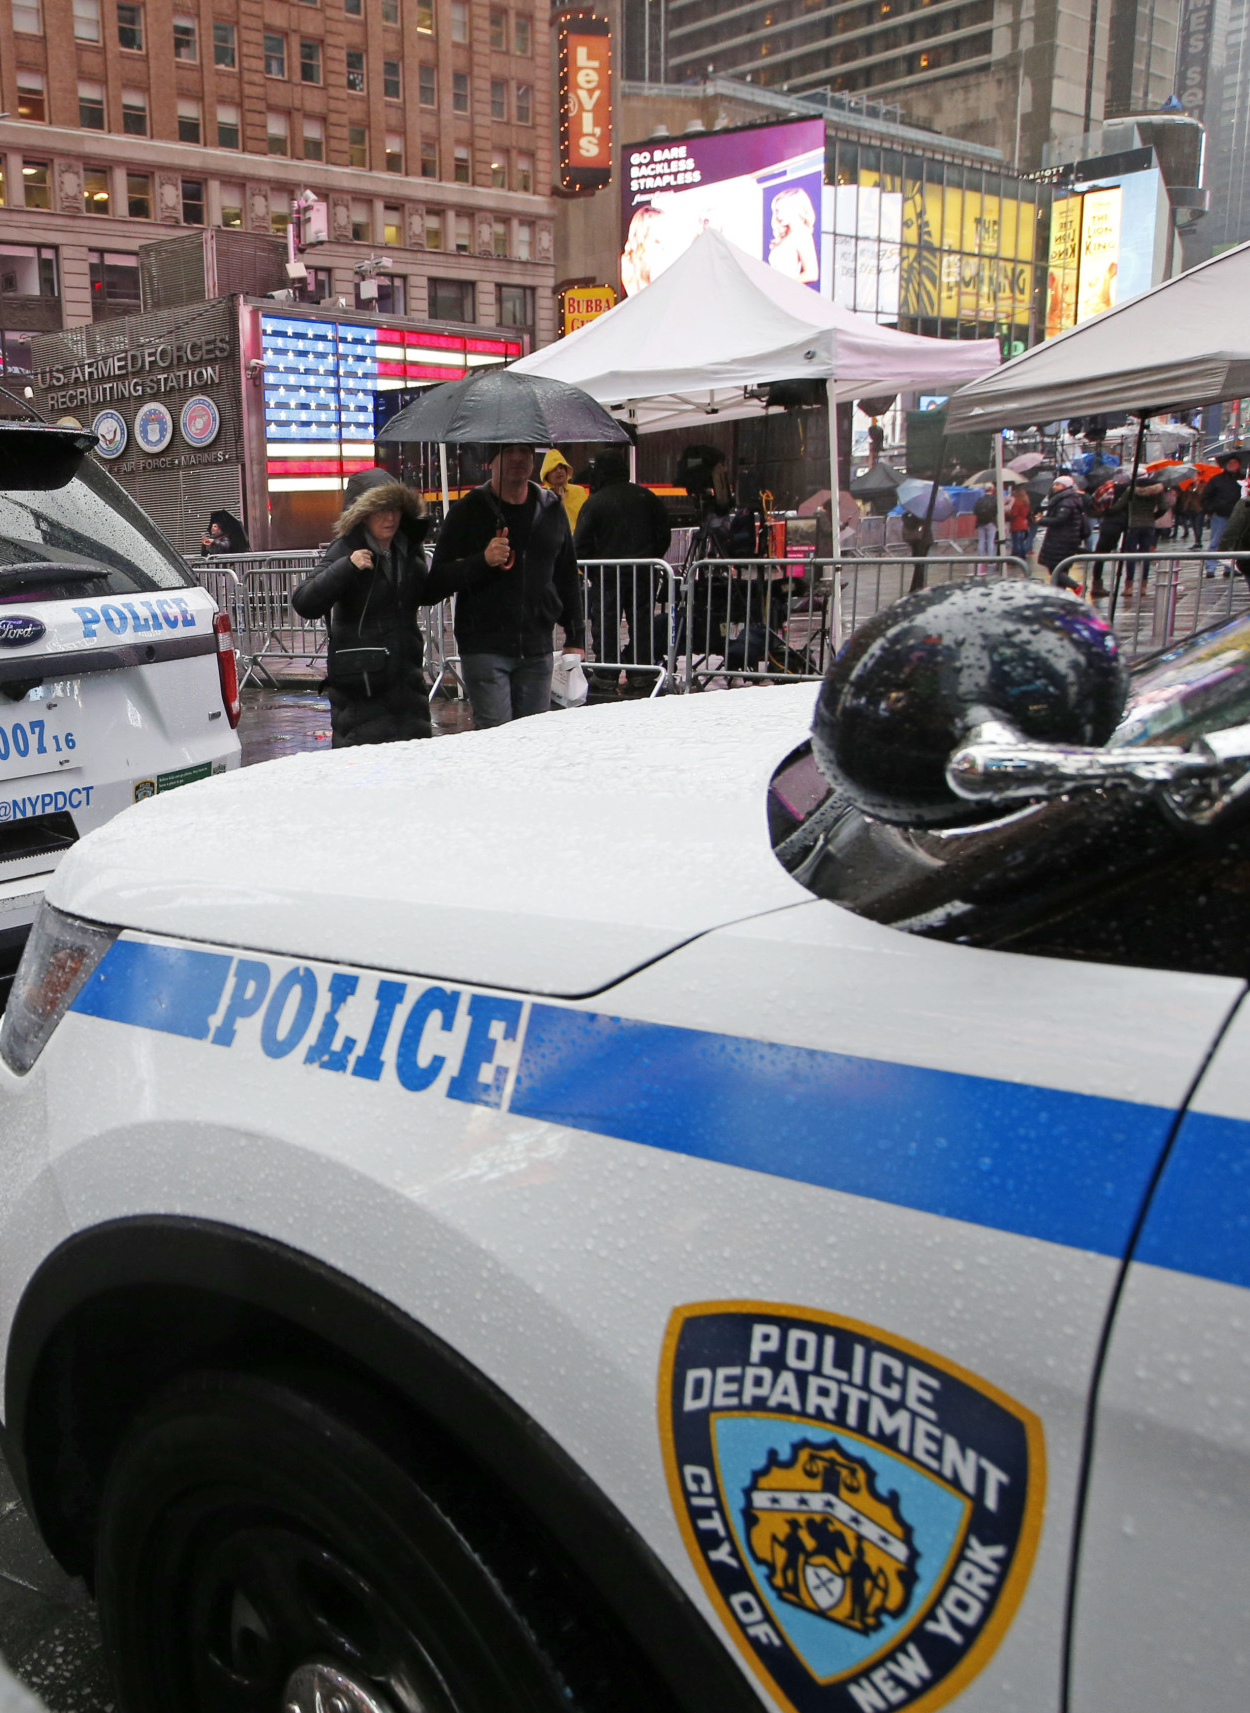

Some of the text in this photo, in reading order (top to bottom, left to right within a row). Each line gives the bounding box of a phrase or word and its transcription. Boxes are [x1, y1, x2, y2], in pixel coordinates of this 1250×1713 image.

[630, 146, 687, 165] GO BARE
[630, 158, 695, 178] BACKLESS
[630, 170, 701, 191] STRAPLESS
[1092, 214, 1109, 224] THE
[1085, 241, 1116, 256] KING
[567, 297, 611, 314] BUBBA
[71, 350, 143, 383] ARMED
[145, 334, 230, 370] FORCES
[48, 364, 221, 410] RECRUITING STATION
[121, 461, 136, 473] AIR
[139, 457, 172, 471] FORCE
[181, 450, 224, 466] MARINES
[71, 597, 196, 638] POLICE
[52, 732, 76, 752] 16
[211, 956, 527, 1110] POLICE
[749, 1323, 941, 1423] POLICE
[682, 1365, 1010, 1513] DEPARTMENT
[681, 1463, 783, 1648] CITY OF
[847, 1534, 1007, 1713] NEW YORK
